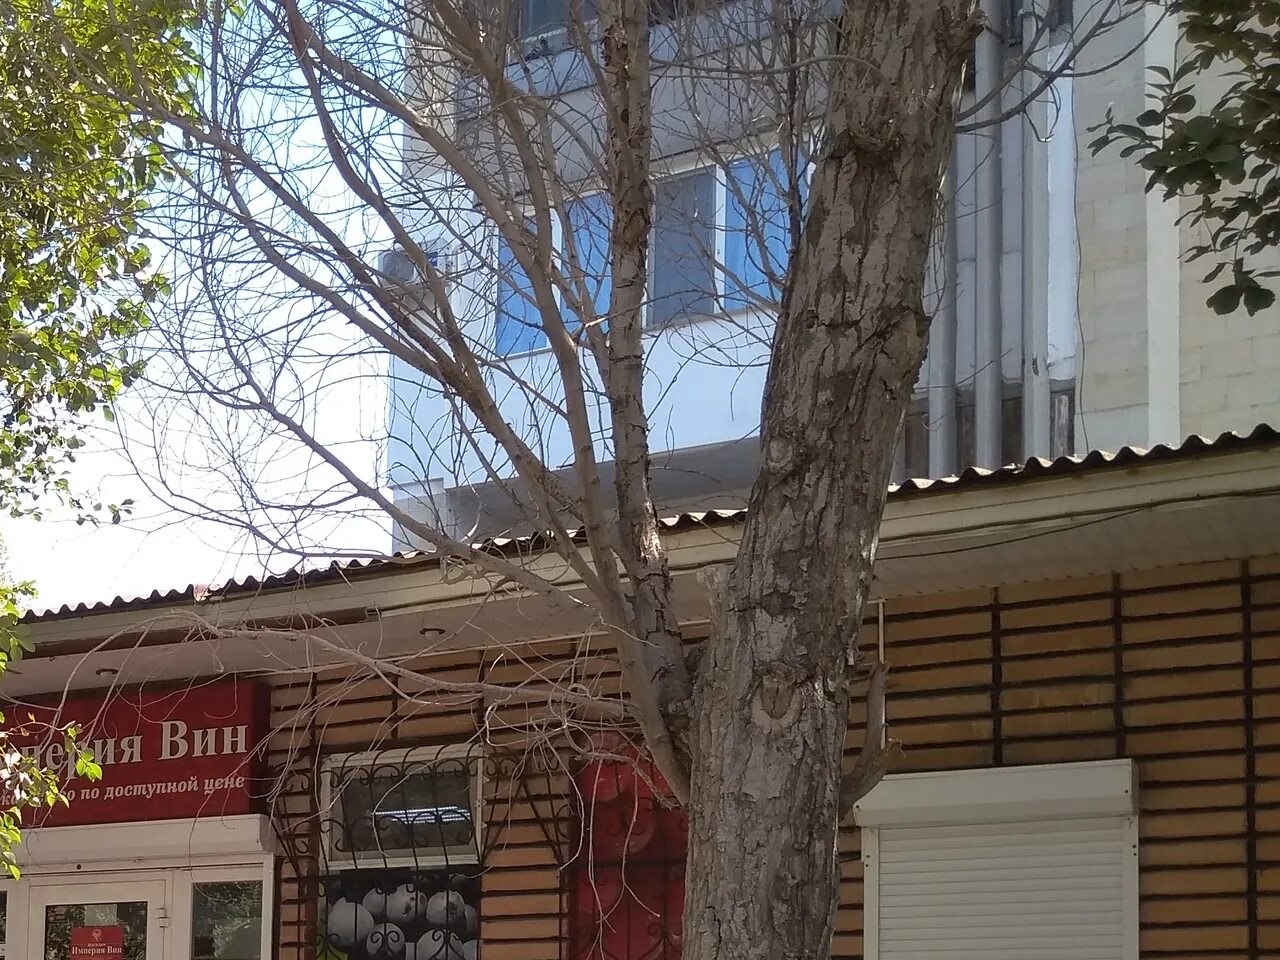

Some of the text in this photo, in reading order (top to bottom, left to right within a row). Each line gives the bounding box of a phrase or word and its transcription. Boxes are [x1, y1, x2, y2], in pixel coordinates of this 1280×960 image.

[157, 719, 249, 761] Вин
[80, 788, 100, 800] по
[104, 776, 198, 800] доступной
[204, 776, 245, 795] цене
[72, 945, 122, 956] Империя Вин
